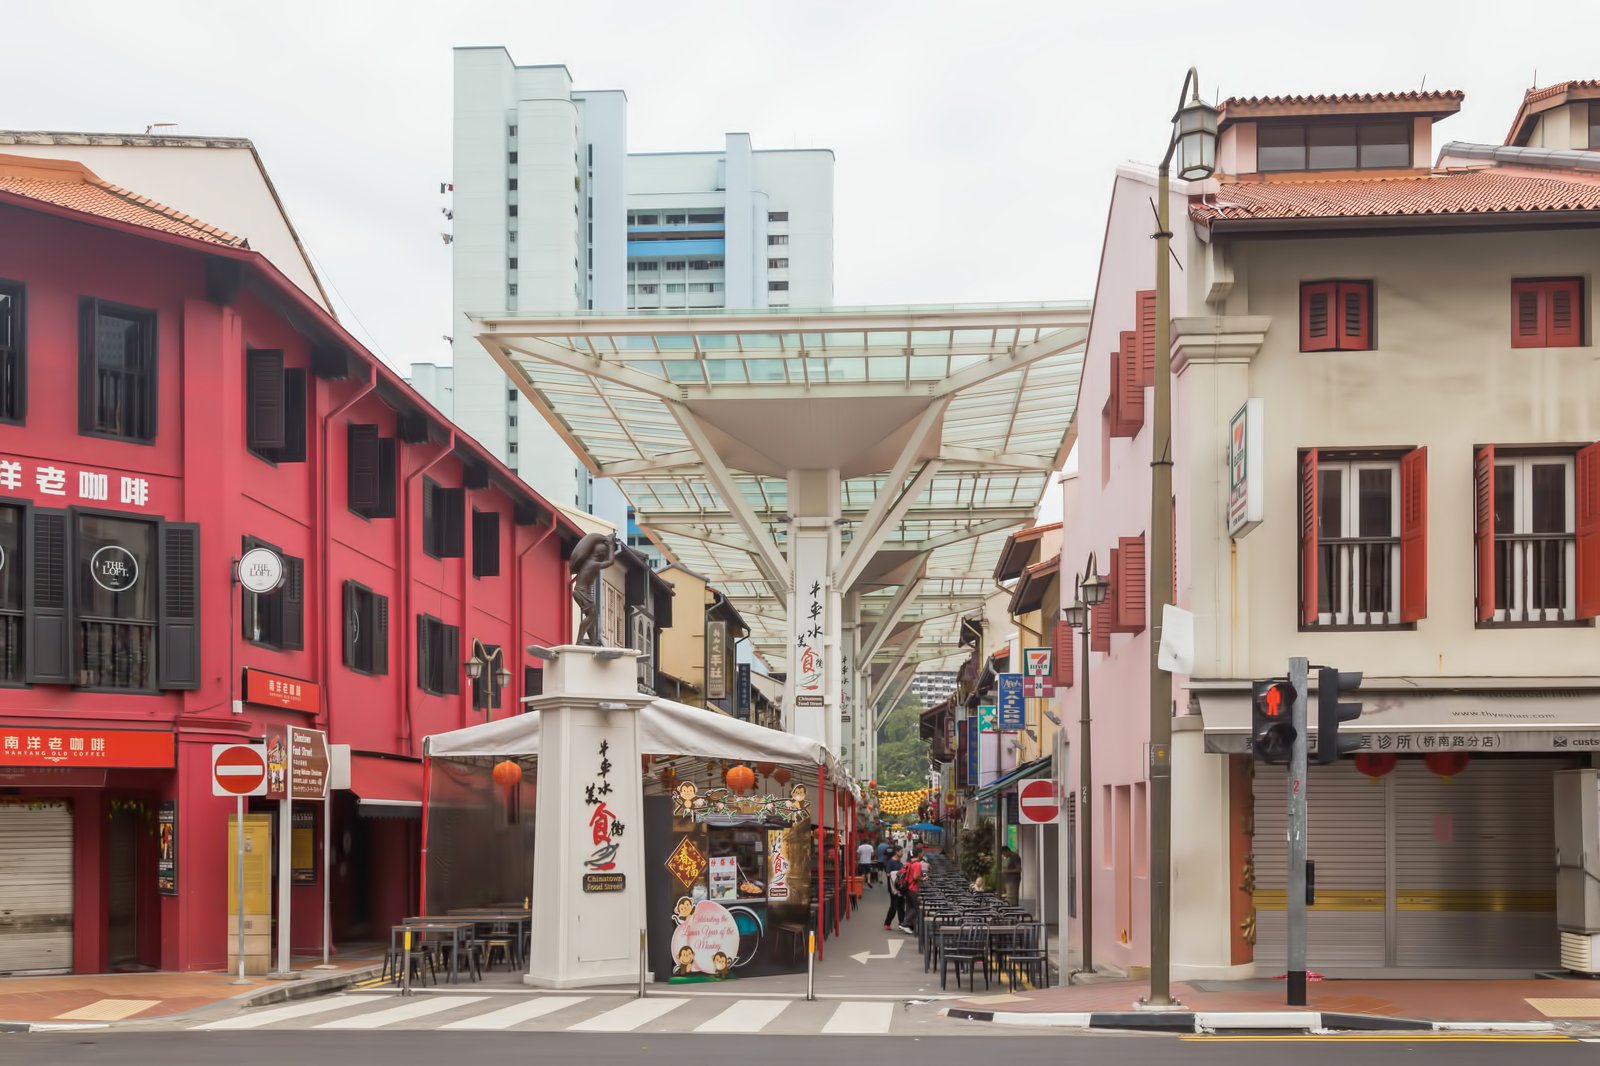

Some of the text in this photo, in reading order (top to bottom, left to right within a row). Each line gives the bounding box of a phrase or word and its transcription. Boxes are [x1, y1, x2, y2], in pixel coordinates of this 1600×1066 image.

[105, 561, 124, 569] THE
[1451, 710, 1555, 719] www.thyeshan.com
[4, 736, 105, 751] 南洋老咖啡
[587, 875, 623, 883] Chinatown
[587, 883, 603, 891] Food
